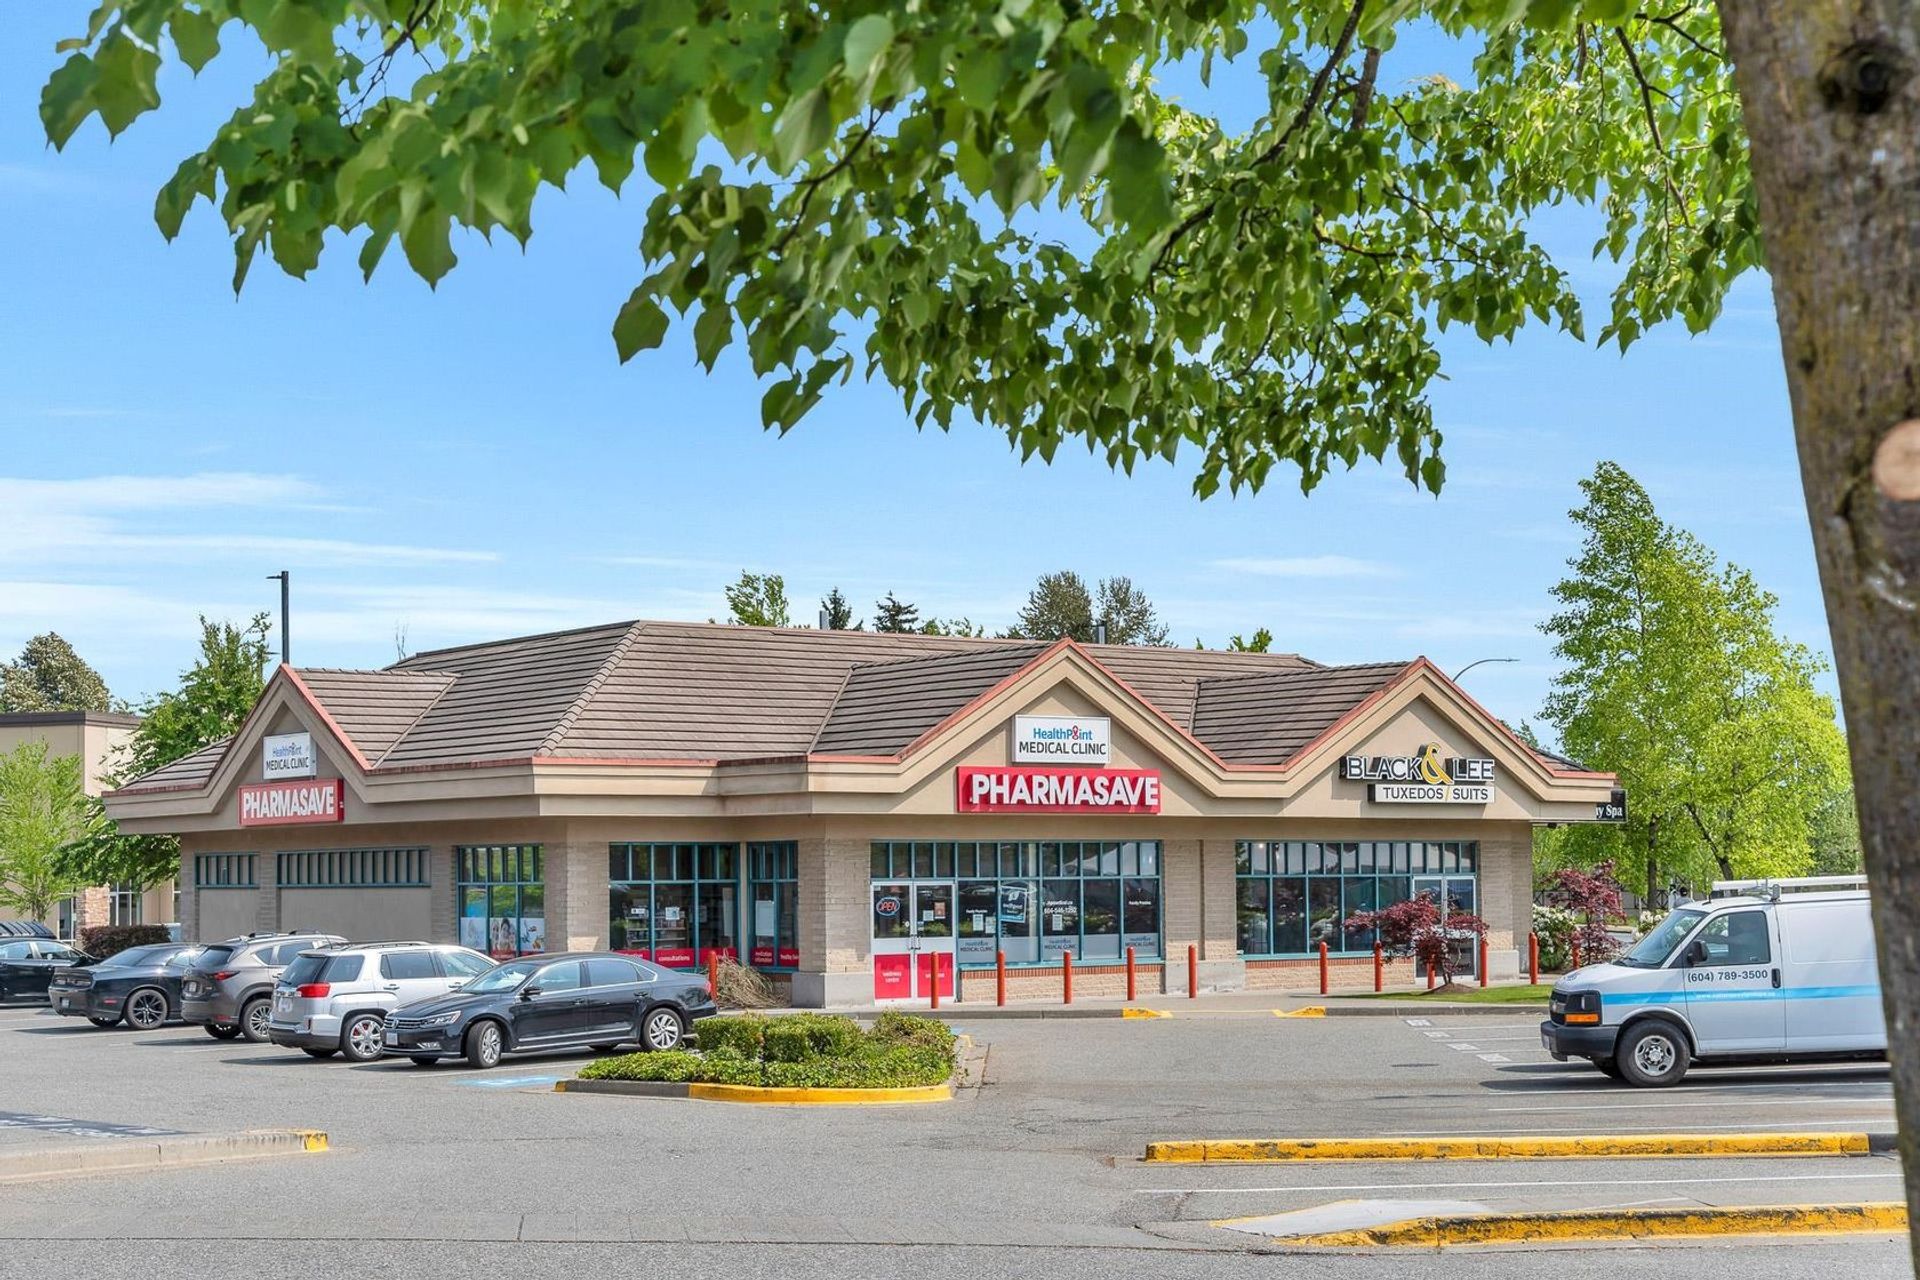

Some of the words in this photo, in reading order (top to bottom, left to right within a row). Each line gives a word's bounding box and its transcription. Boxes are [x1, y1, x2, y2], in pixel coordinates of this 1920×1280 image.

[1019, 741, 1069, 755] MEDICAL
[1070, 742, 1107, 755] CLINIC
[266, 758, 290, 771] MEDICAL
[291, 756, 309, 769] CLINIC
[1346, 756, 1422, 781] BLACK
[1452, 758, 1495, 782] LEE
[971, 773, 1159, 806] PHARMASAVE
[1382, 787, 1444, 800] TUXEDOS
[1452, 787, 1489, 800] SUITS
[243, 786, 335, 819] PHARMASAVE
[1605, 804, 1623, 818] Spa
[1687, 972, 1714, 982] (604)
[1717, 970, 1768, 980] 789-3500
